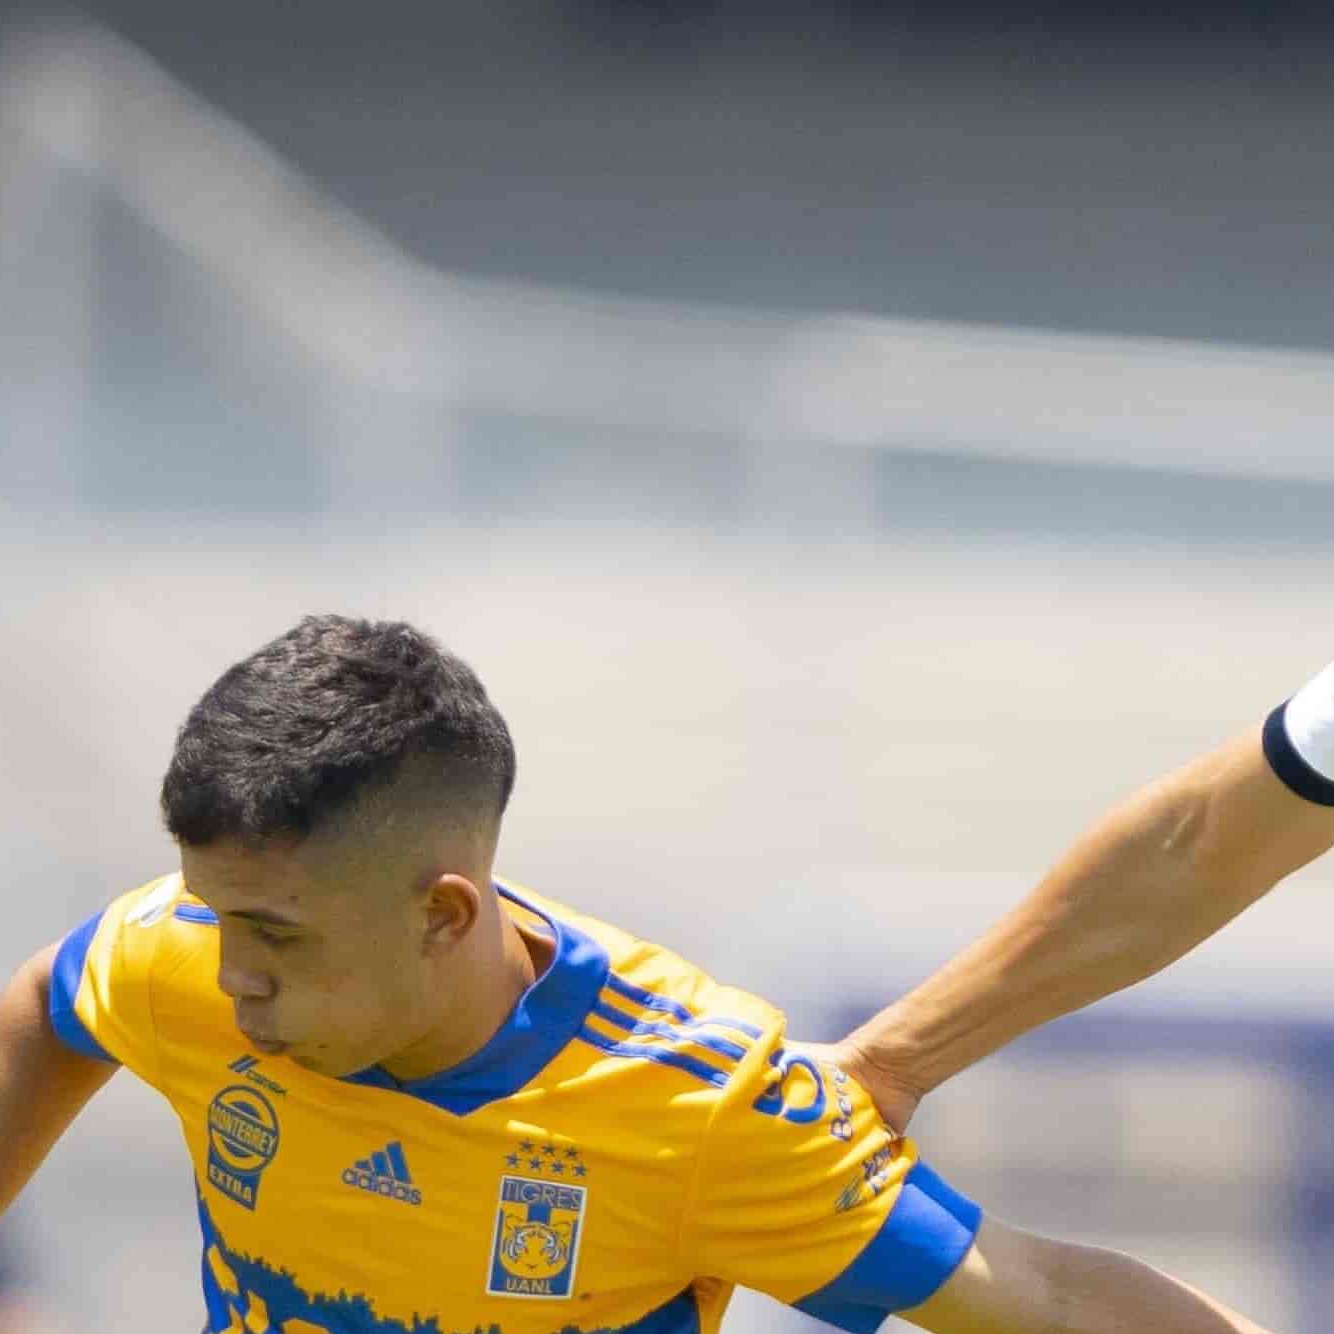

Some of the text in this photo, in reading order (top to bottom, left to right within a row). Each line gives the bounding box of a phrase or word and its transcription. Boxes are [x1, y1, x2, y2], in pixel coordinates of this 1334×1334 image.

[209, 1163, 253, 1203] EXTRA
[341, 1167, 423, 1206] adidas
[504, 1179, 584, 1209] TIGRES
[505, 1277, 554, 1295] UANL
